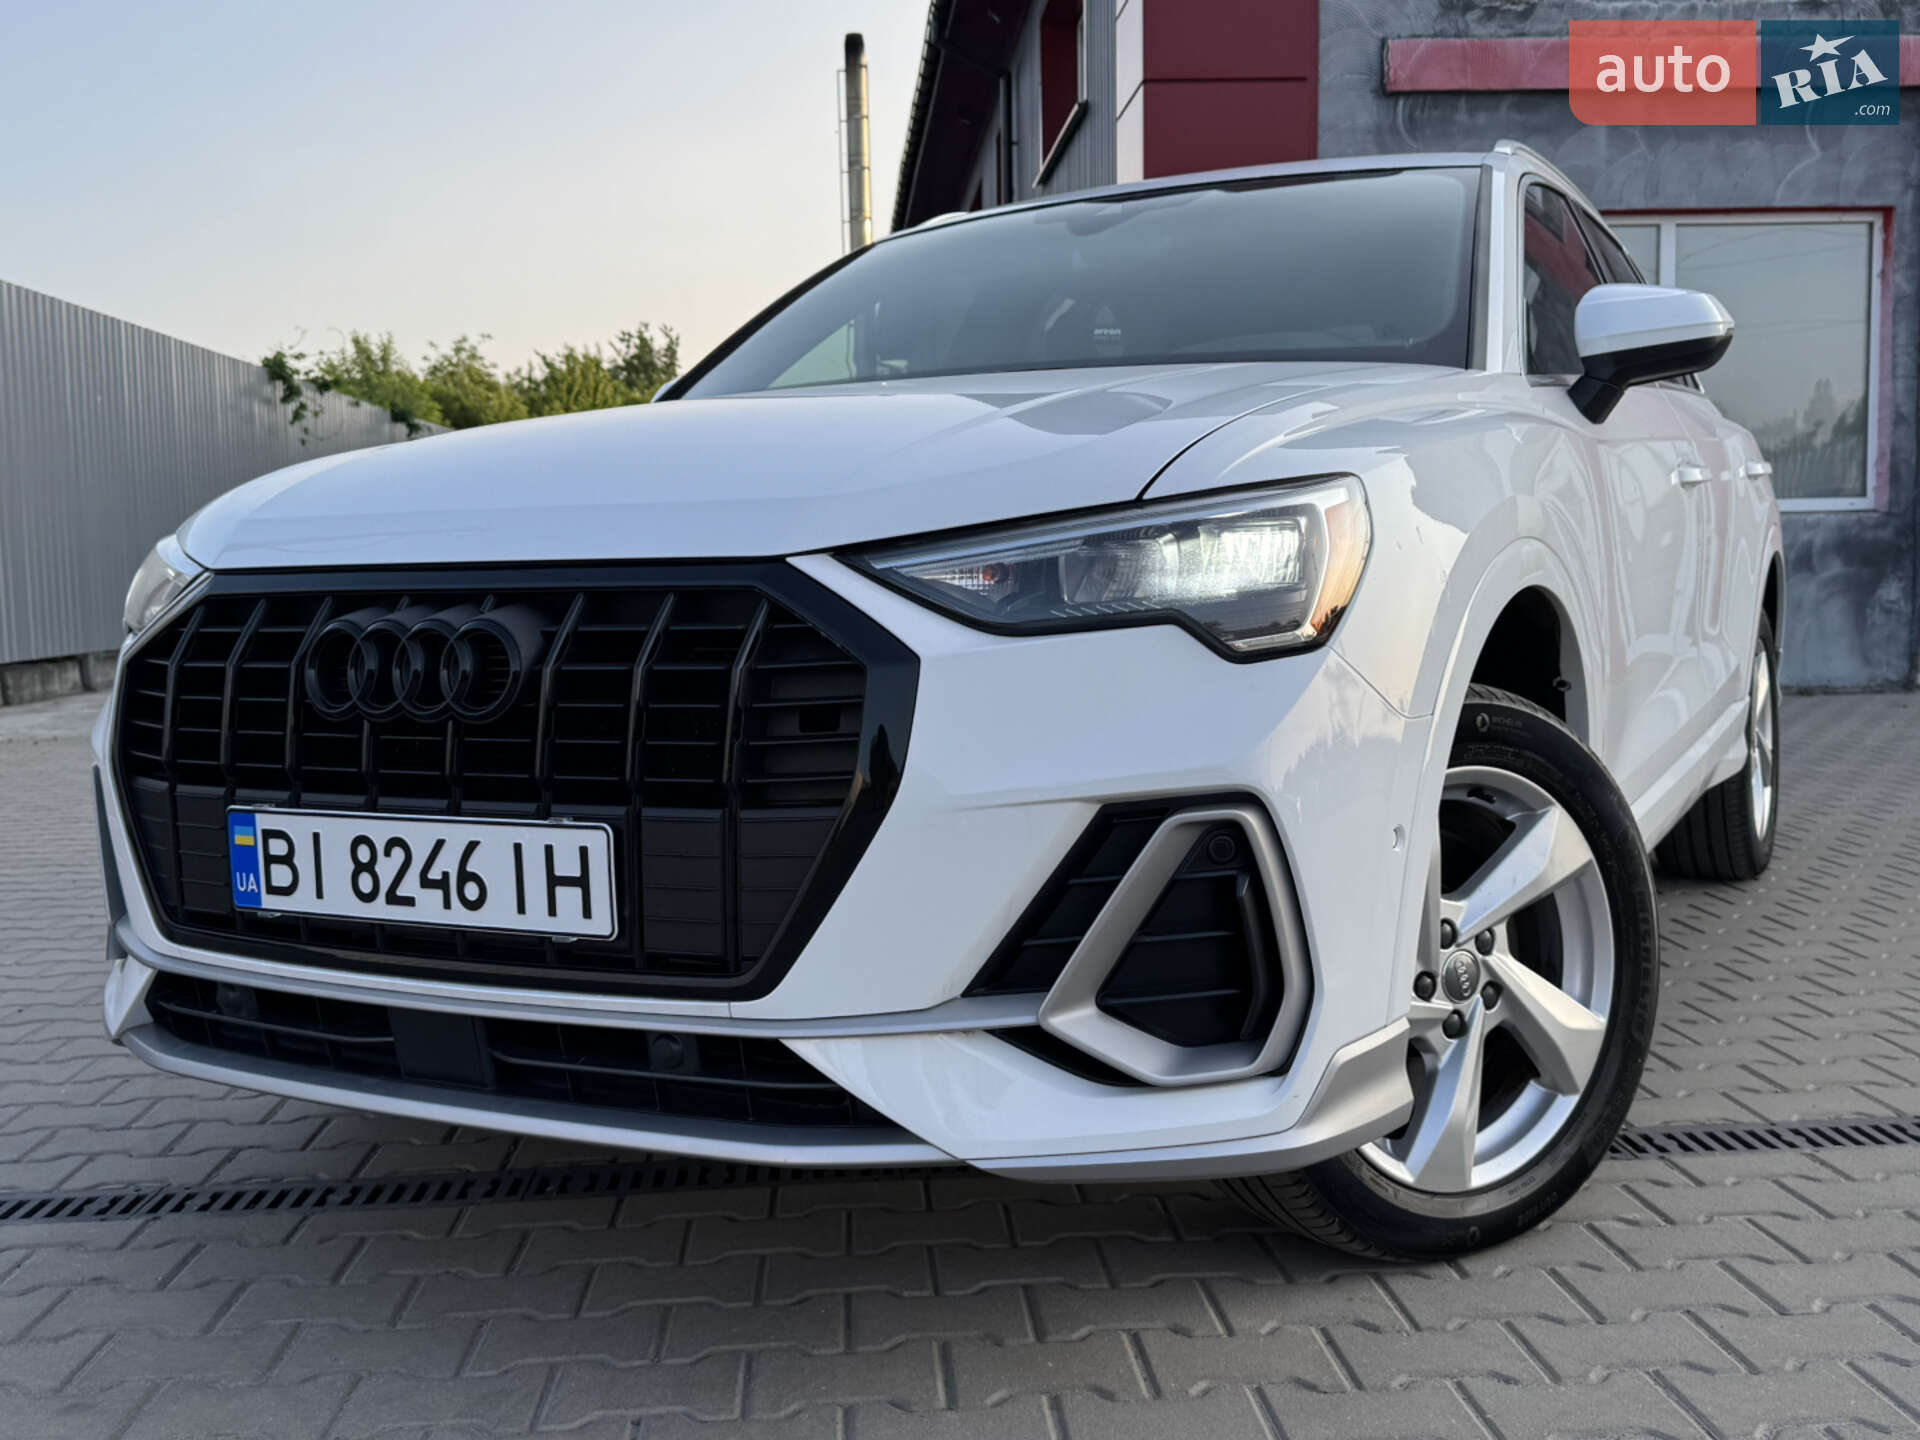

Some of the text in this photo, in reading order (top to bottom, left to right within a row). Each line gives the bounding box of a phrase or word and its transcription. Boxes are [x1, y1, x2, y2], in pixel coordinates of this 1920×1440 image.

[236, 872, 259, 893] UA
[261, 828, 593, 920] BI 8246 IH
